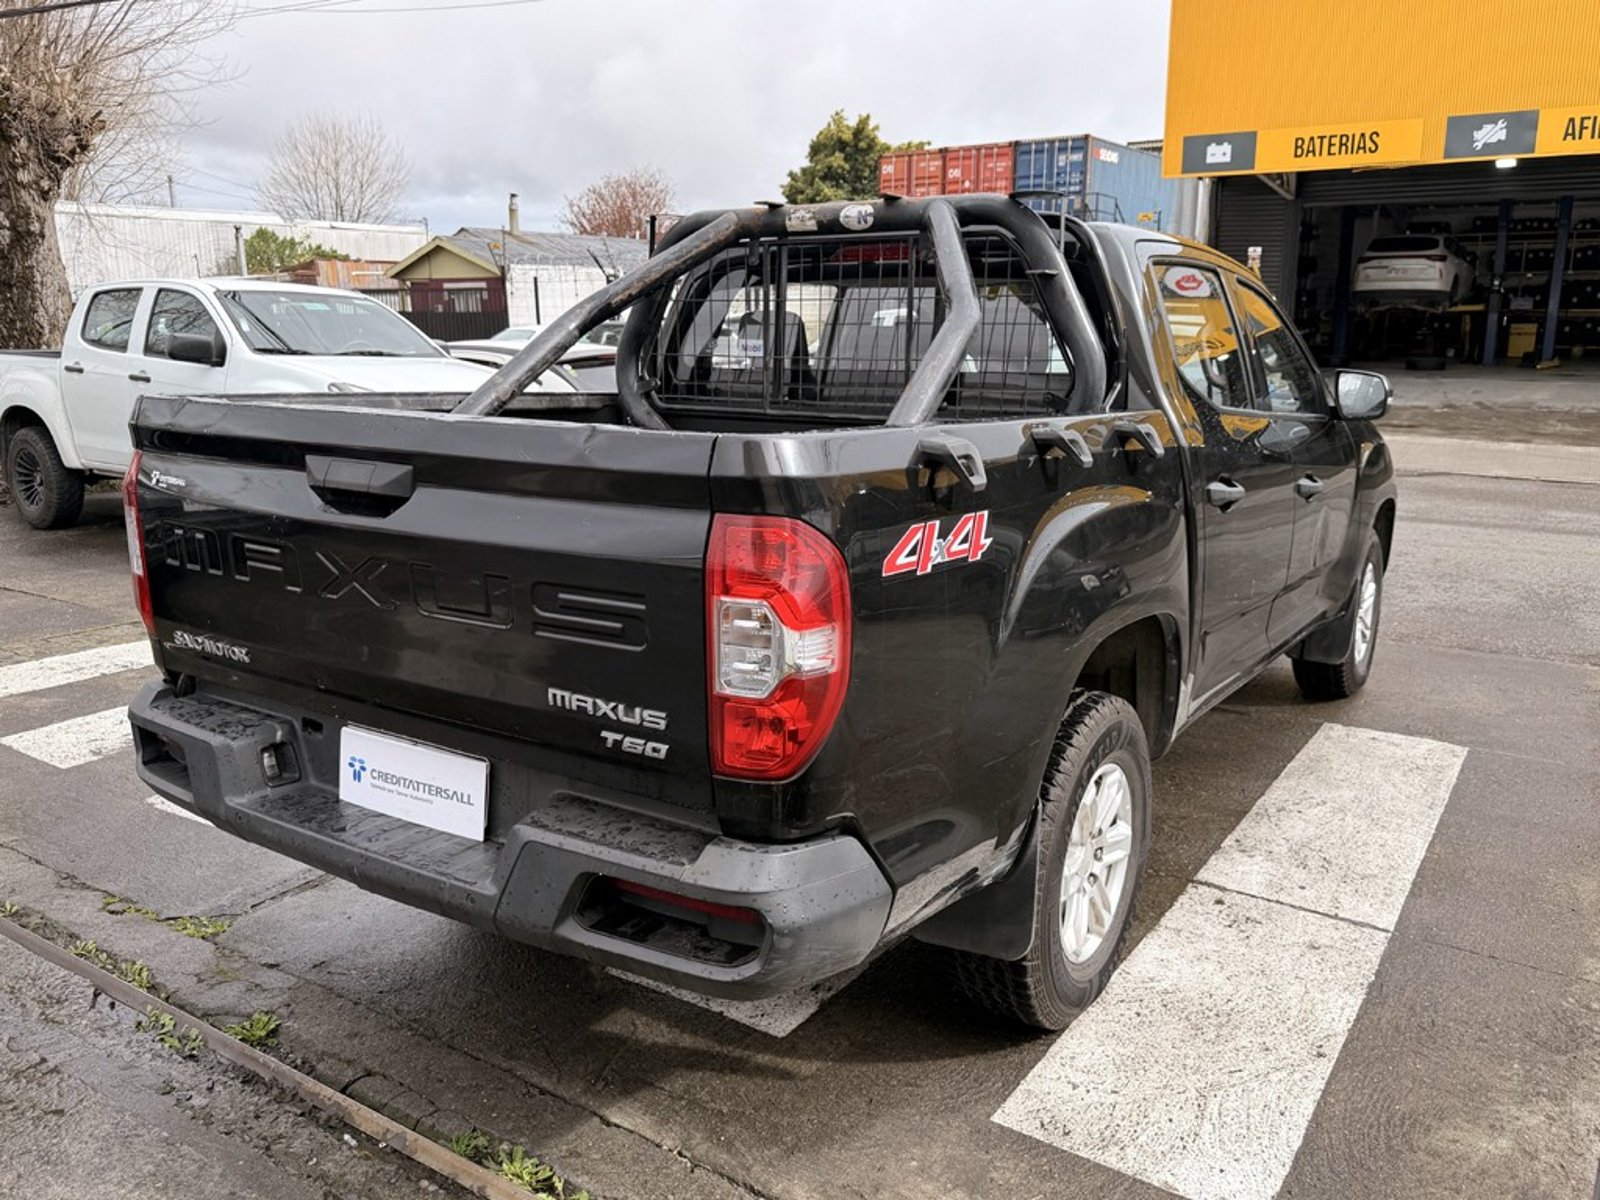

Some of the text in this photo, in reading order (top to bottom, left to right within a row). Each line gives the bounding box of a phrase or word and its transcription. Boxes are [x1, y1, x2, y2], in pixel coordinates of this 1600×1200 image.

[1293, 131, 1380, 159] BATERIAS
[1562, 115, 1600, 141] AFI
[882, 510, 993, 577] 4x4
[160, 520, 649, 652] MAXUS
[203, 639, 251, 663] MOTOR
[548, 687, 668, 731] MAXUS
[600, 730, 670, 760] T60
[370, 768, 475, 807] CREDITATTERSALL
